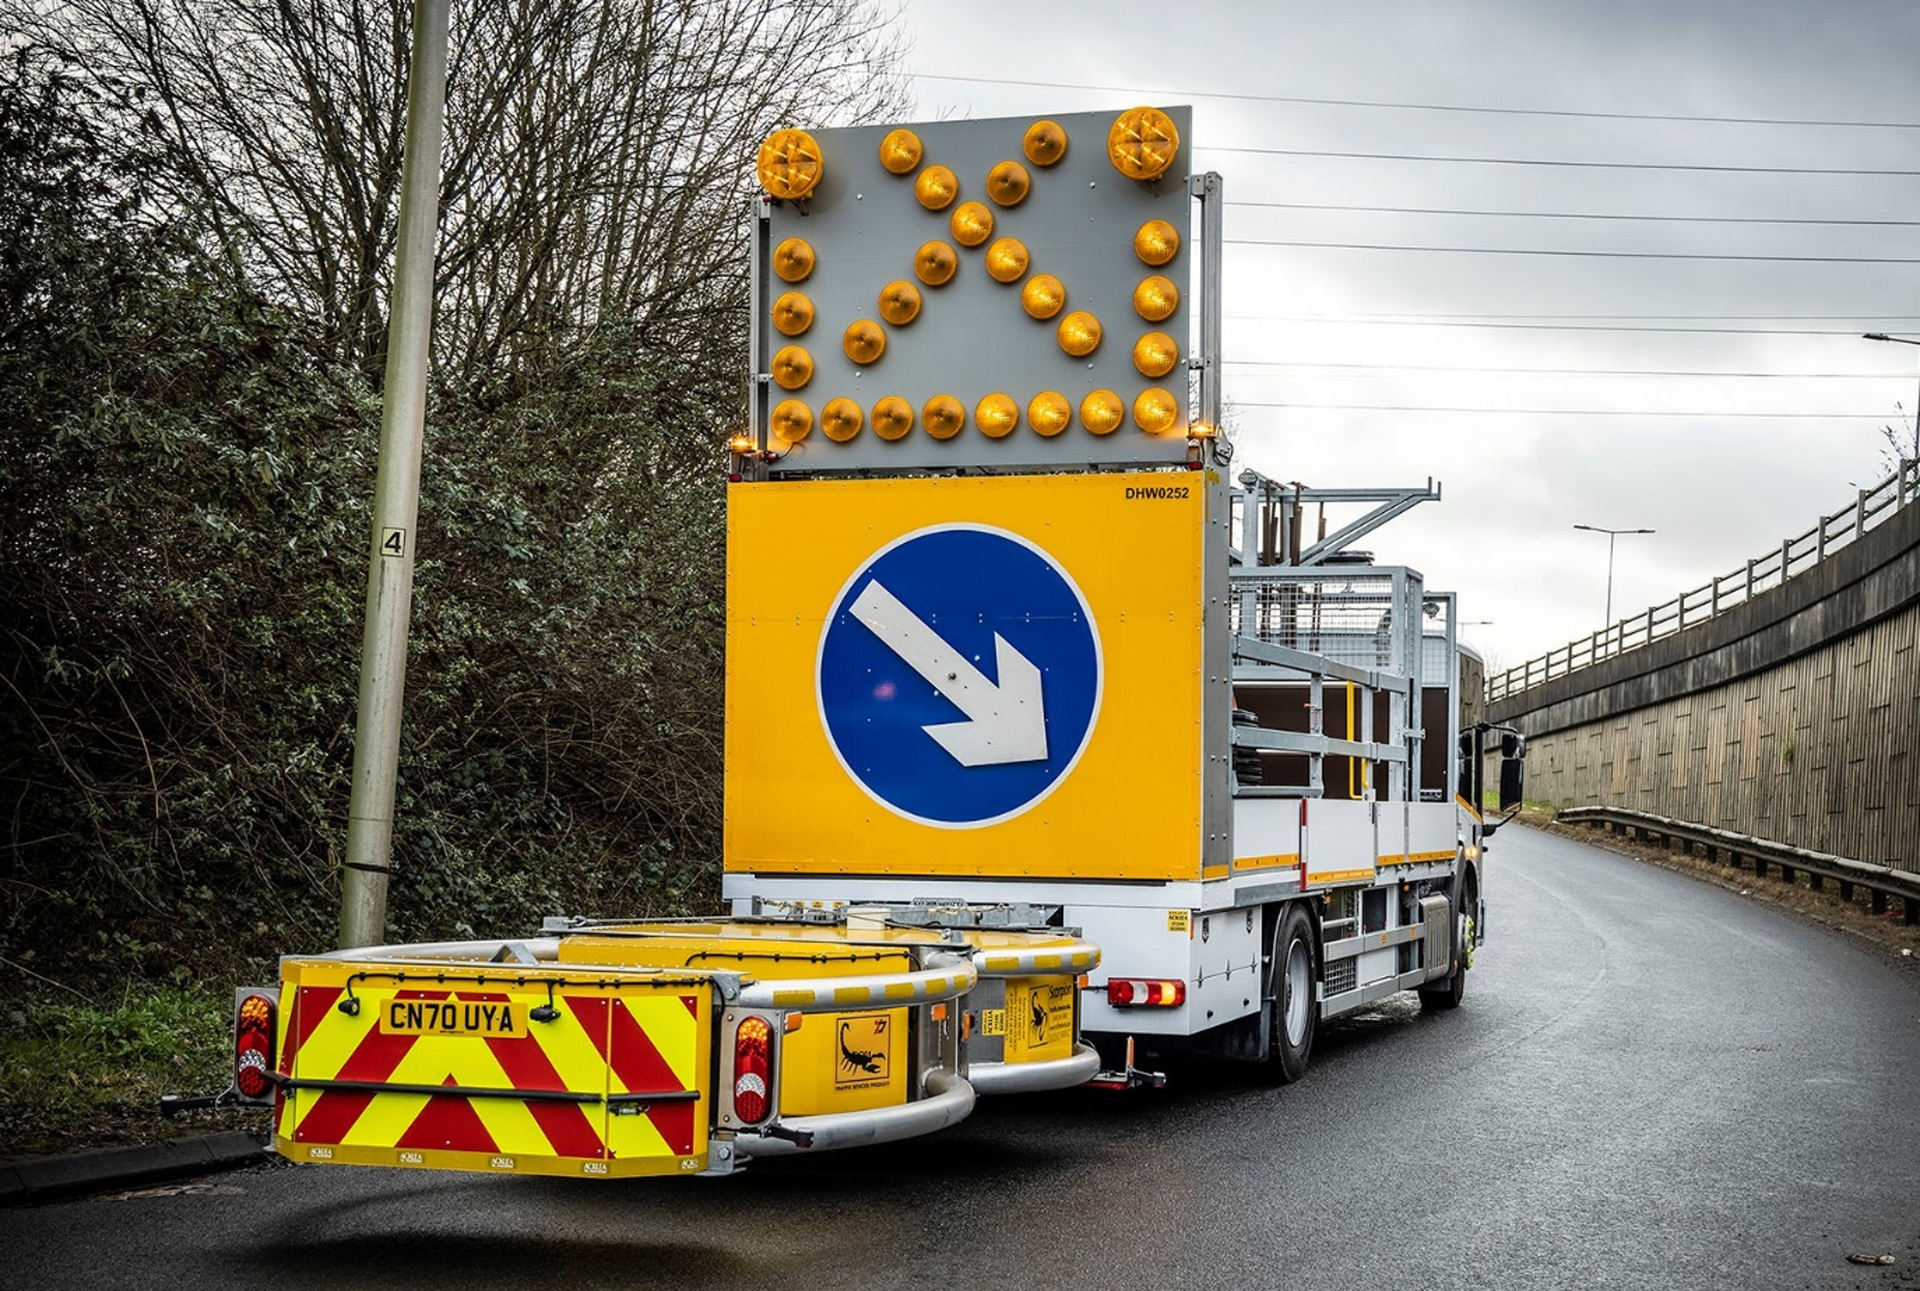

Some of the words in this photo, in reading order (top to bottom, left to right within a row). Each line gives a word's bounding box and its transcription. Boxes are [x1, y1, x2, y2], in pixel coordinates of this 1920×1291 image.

[1126, 487, 1189, 499] DHW0252
[384, 531, 401, 553] 4
[390, 1002, 456, 1030] CN70
[464, 1004, 514, 1032] UYA
